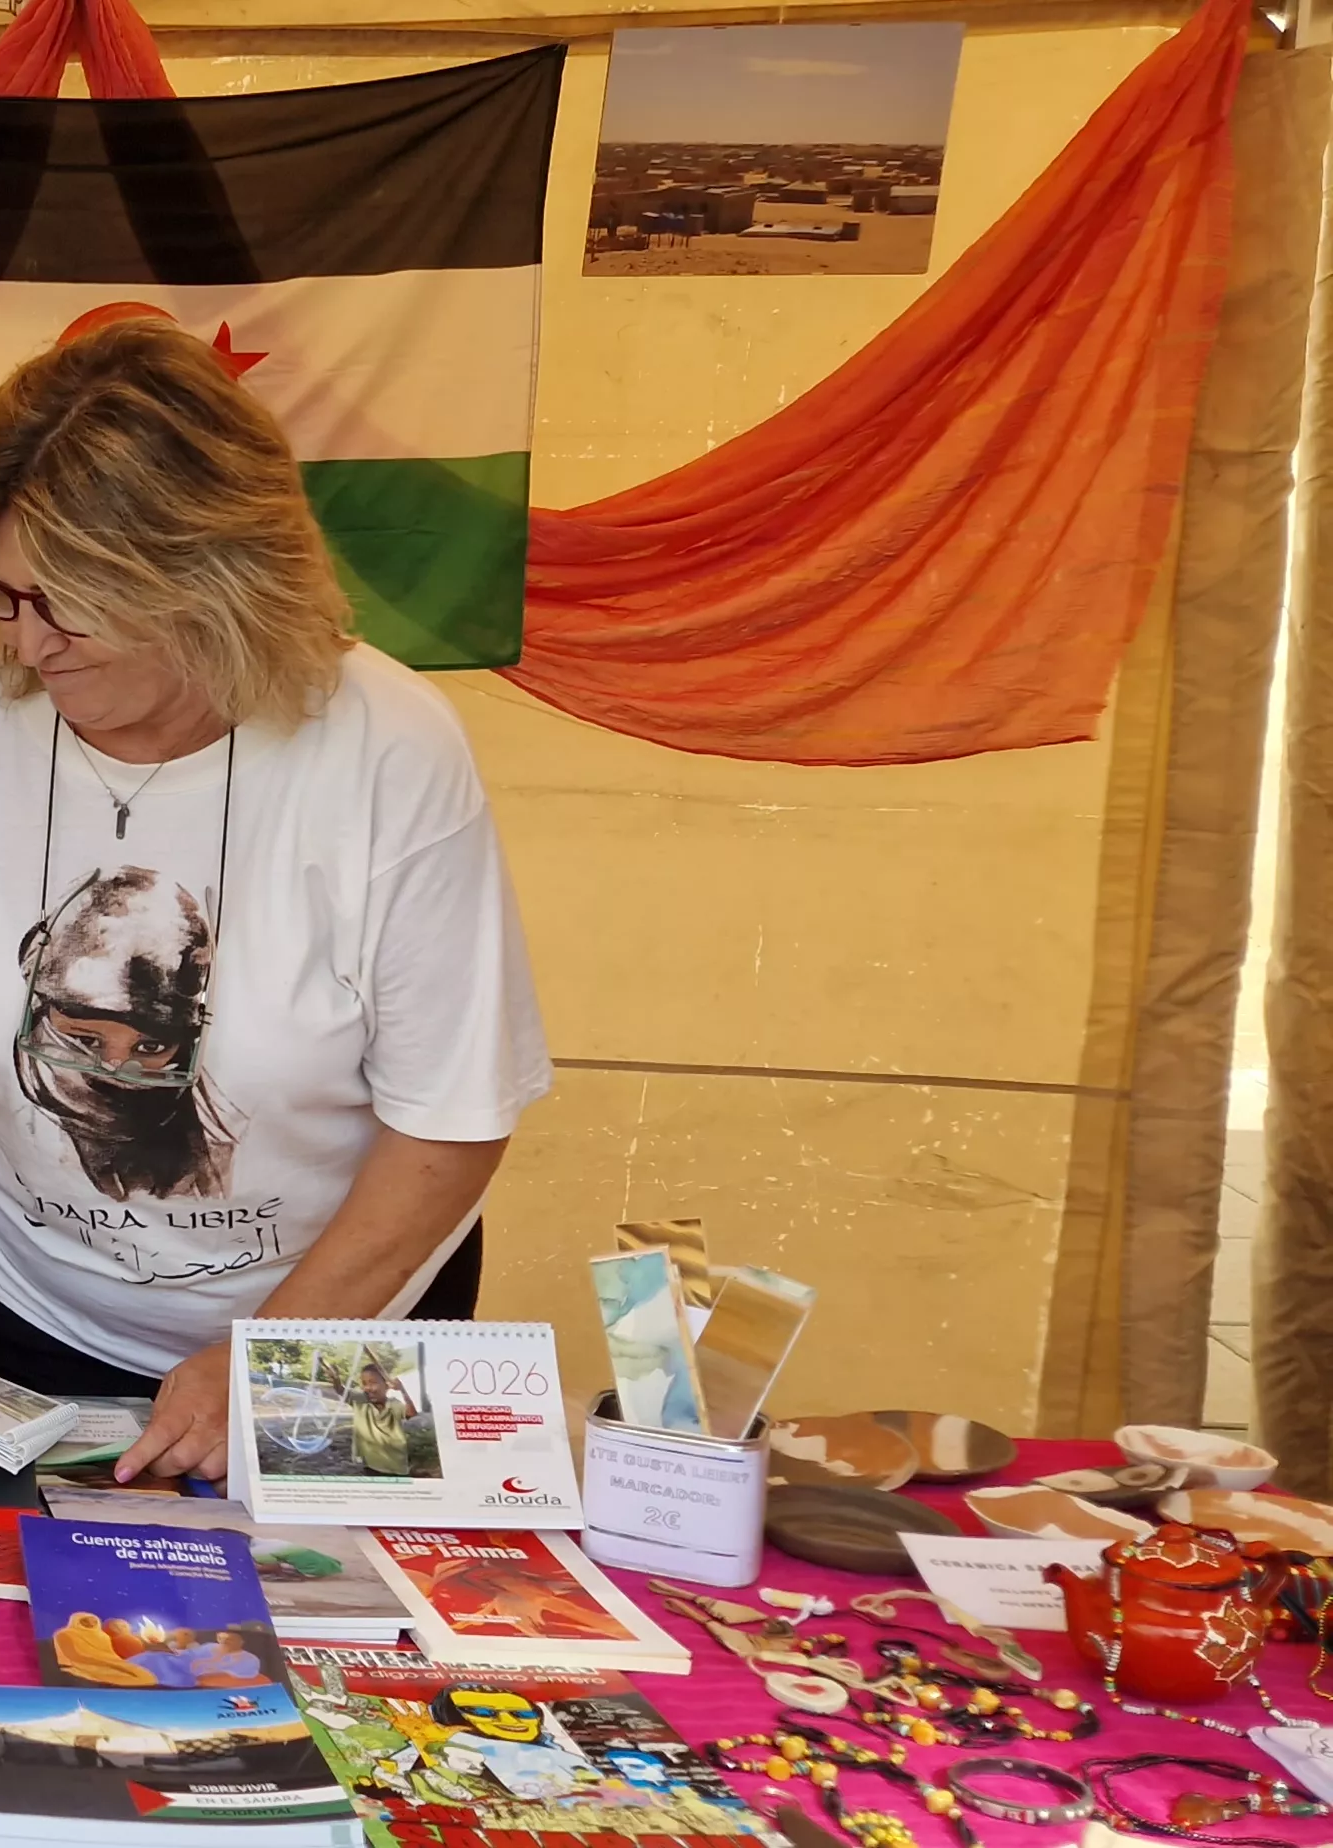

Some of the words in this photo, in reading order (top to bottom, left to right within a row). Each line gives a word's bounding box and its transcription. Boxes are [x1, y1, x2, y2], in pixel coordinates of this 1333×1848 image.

[167, 1198, 281, 1229] LIBRE
[447, 1359, 548, 1396] 2026
[483, 1415, 542, 1423] CAMPAMENTOS
[623, 1453, 686, 1476] GUSTA
[692, 1465, 750, 1484] LEER?
[485, 1493, 562, 1505] alouda
[643, 1506, 681, 1530] 2€
[71, 1532, 141, 1548] Cuentos
[144, 1538, 224, 1555] saharauis
[379, 1529, 460, 1545] Ritos
[116, 1548, 138, 1560] de
[142, 1549, 164, 1561] mi
[167, 1549, 227, 1566] abuelo
[392, 1542, 432, 1556] de
[369, 1669, 419, 1684] digo
[424, 1670, 444, 1680] al
[451, 1671, 529, 1683] mundo
[534, 1672, 607, 1685] entero
[189, 1783, 279, 1794] SOBREVIVIR
[196, 1796, 217, 1804] EN
[221, 1796, 239, 1804] EL
[201, 1808, 297, 1817] OCCIDENTAL
